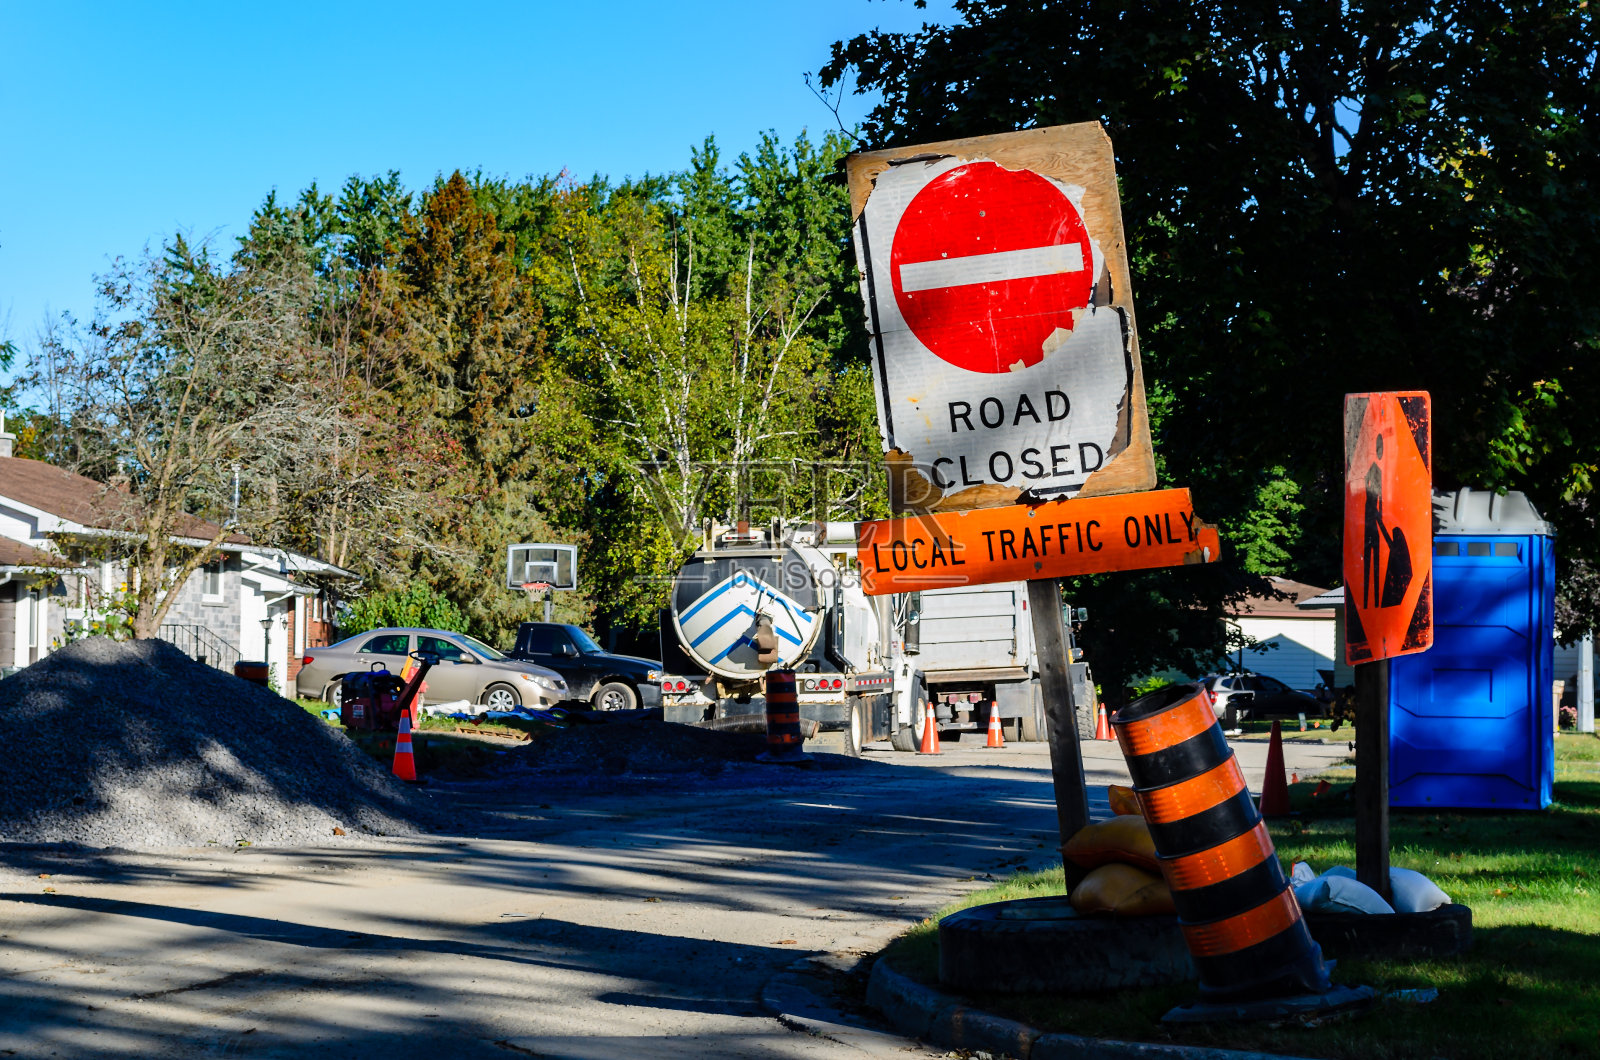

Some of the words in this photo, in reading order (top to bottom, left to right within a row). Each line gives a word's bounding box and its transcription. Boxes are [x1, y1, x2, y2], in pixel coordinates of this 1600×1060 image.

[948, 390, 1071, 432] ROAD
[932, 442, 1104, 488] CLOSED
[873, 535, 966, 573] LOCAL
[983, 519, 1103, 561] TRAFFIC
[1124, 511, 1195, 548] ONLY
